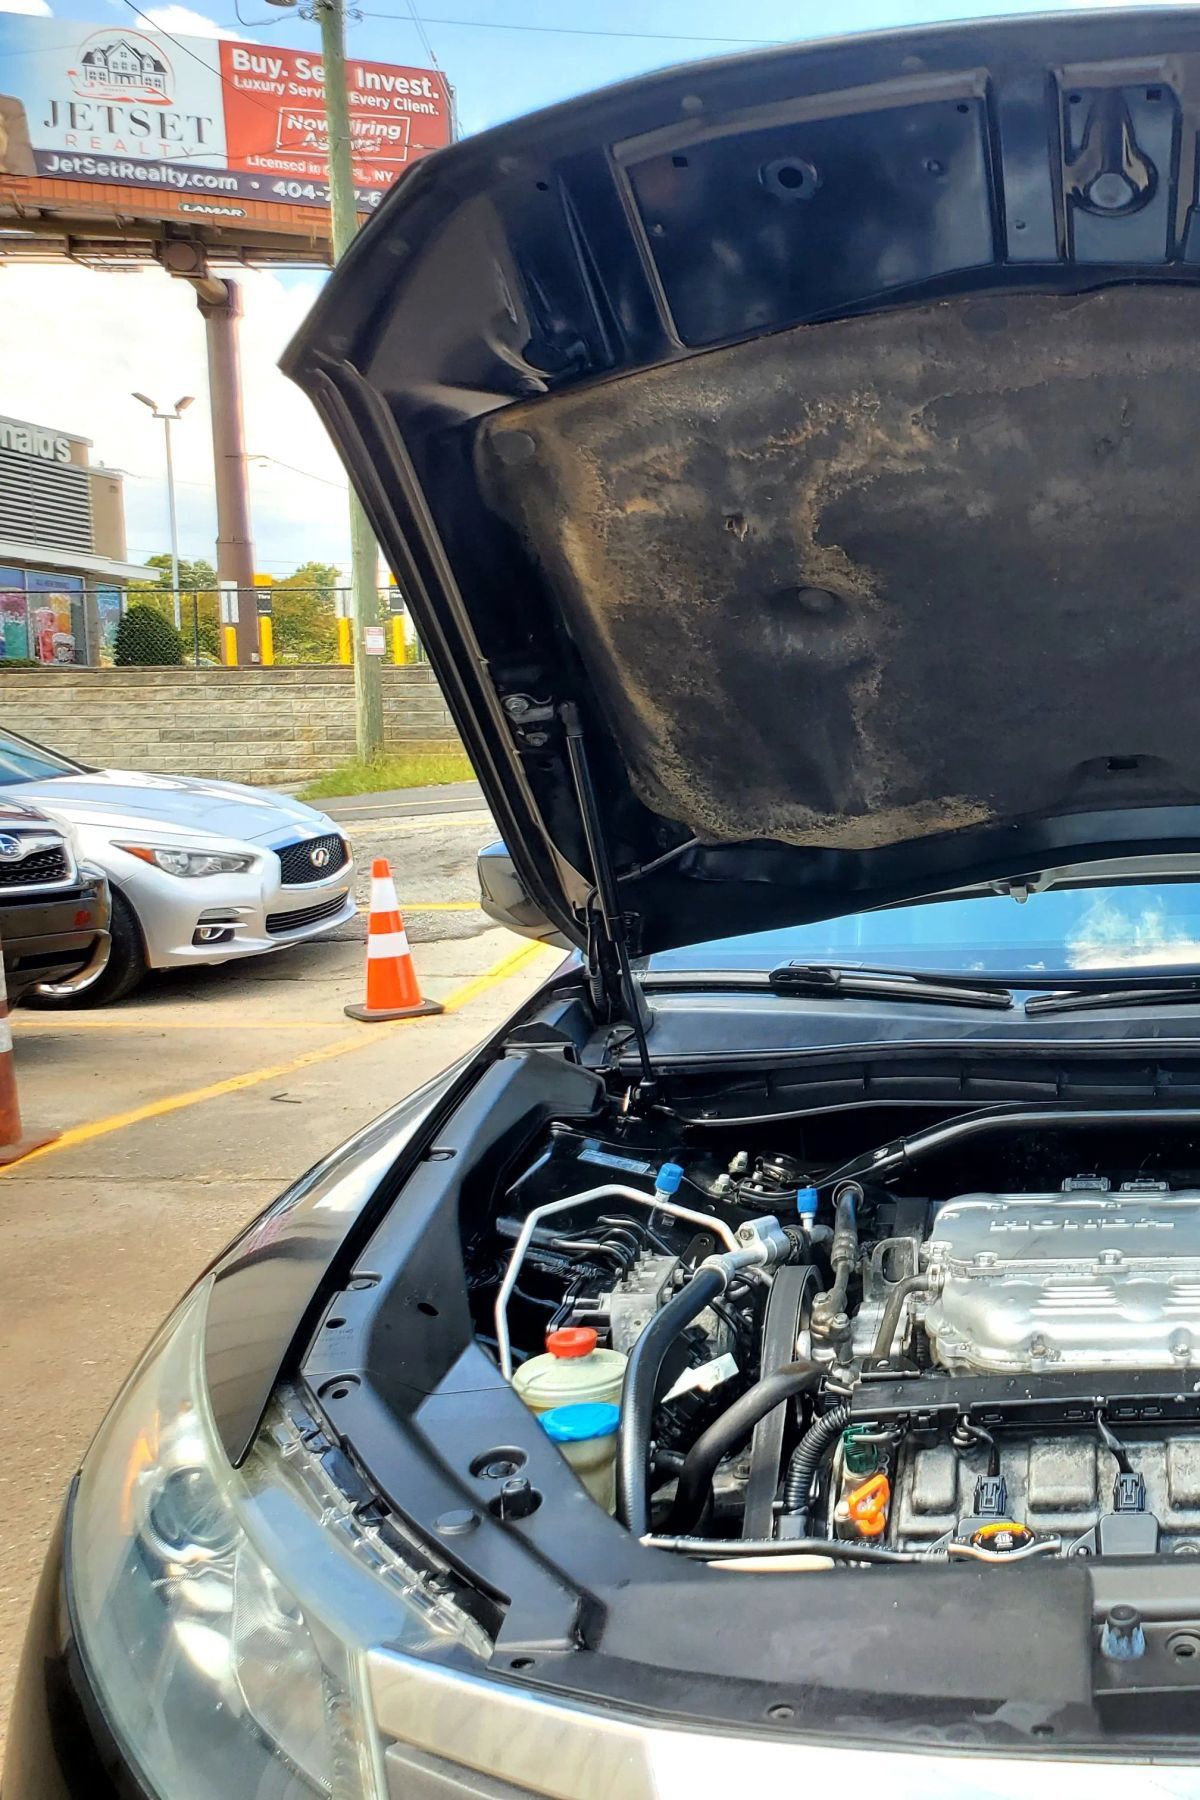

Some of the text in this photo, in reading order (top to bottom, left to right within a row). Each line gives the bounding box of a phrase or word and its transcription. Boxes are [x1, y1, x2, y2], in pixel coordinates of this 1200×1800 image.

[231, 48, 289, 79] Buy.
[355, 66, 440, 99] Invest.
[233, 74, 440, 116] Luxury Servi Every Client.
[43, 99, 213, 145] JETSET
[64, 133, 194, 160] REALTY
[46, 154, 239, 191] JetSetRealty.com
[246, 154, 307, 172] Licensed
[374, 169, 394, 183] NY
[181, 204, 244, 217] LAMAR
